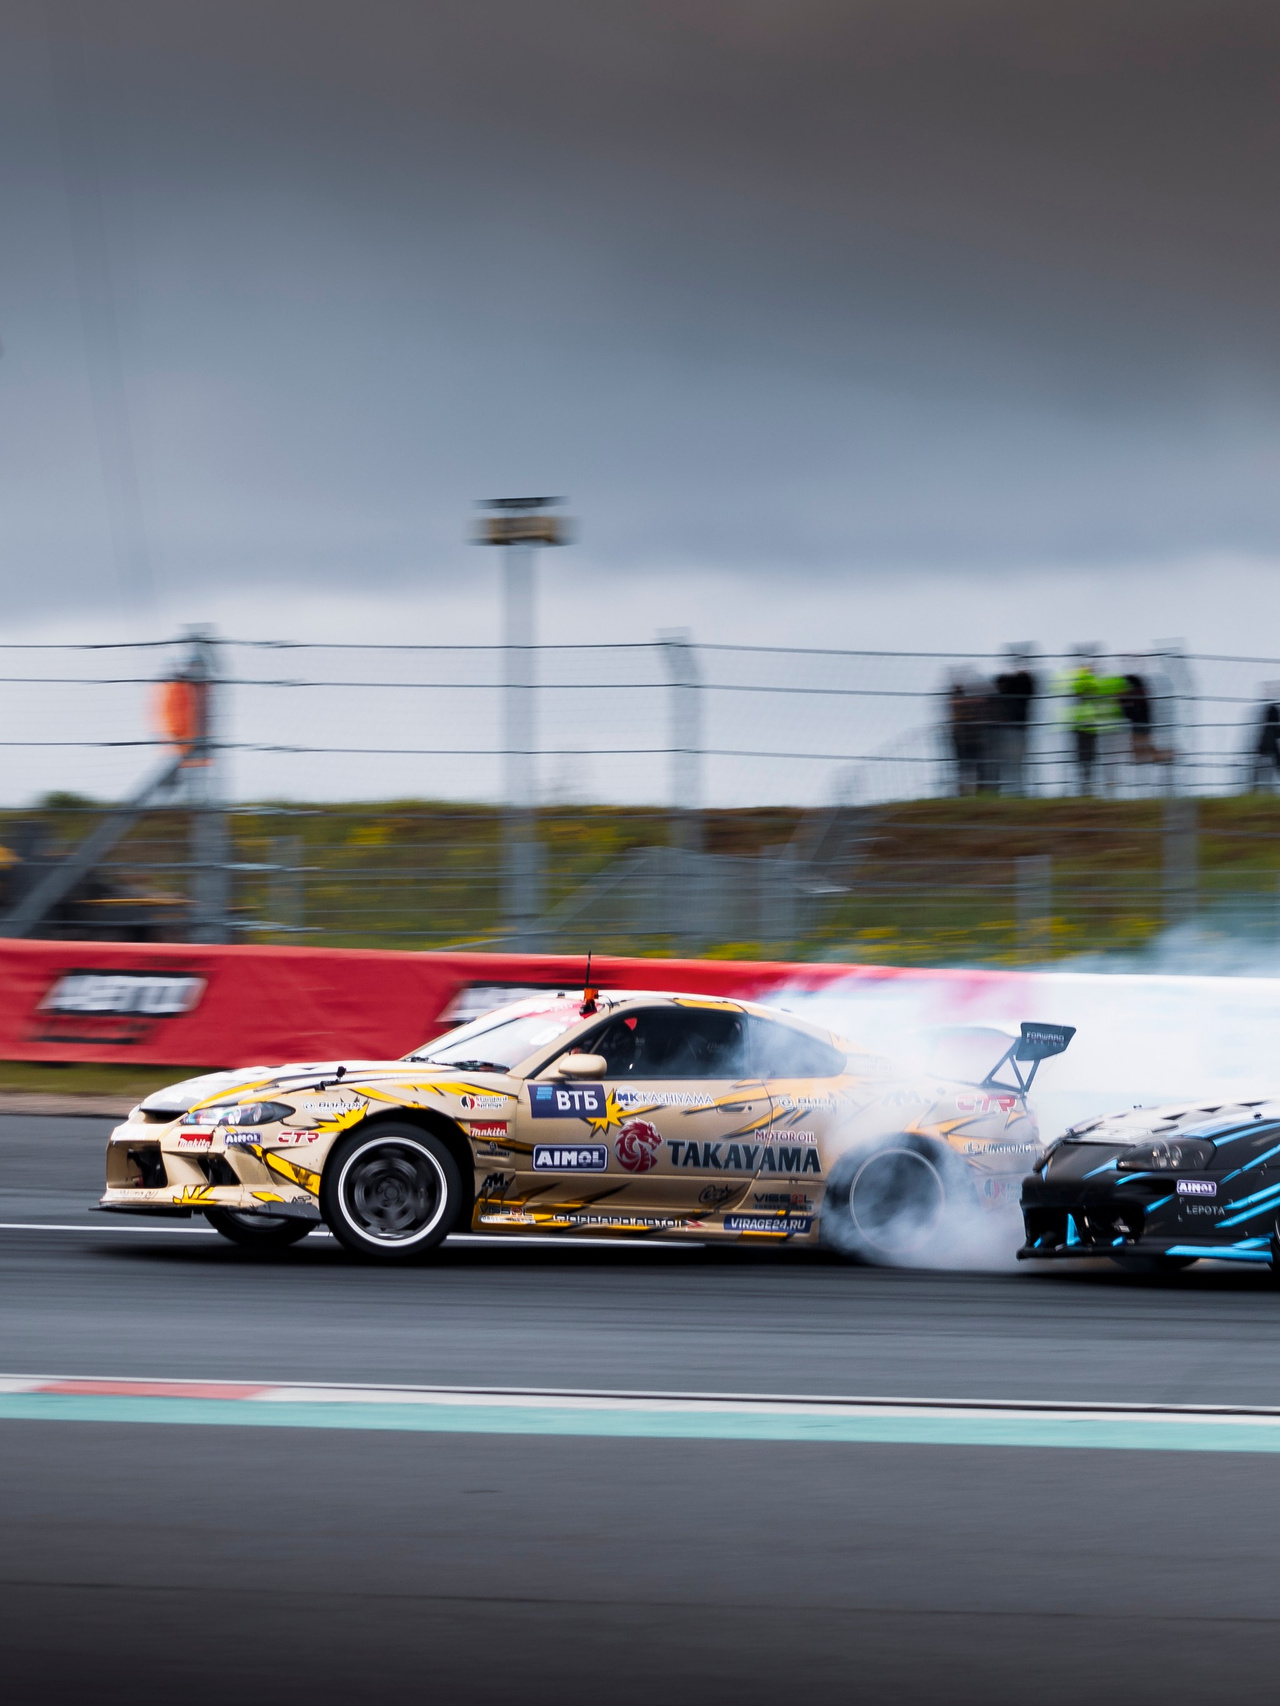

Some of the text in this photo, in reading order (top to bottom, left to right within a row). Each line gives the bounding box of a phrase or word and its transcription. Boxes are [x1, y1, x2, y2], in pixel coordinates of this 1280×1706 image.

[556, 1090, 599, 1110] ВТБ
[641, 1091, 716, 1106] KASHIYAMA
[470, 1127, 508, 1137] makita
[754, 1129, 817, 1144] MOTOR OIL
[982, 1142, 1032, 1154] LINGLONG
[536, 1151, 603, 1166] AIMOL
[666, 1139, 822, 1173] TAKAYAMA
[1186, 1205, 1226, 1216] LEPOTA
[730, 1217, 807, 1230] VIRAGE24.RU
